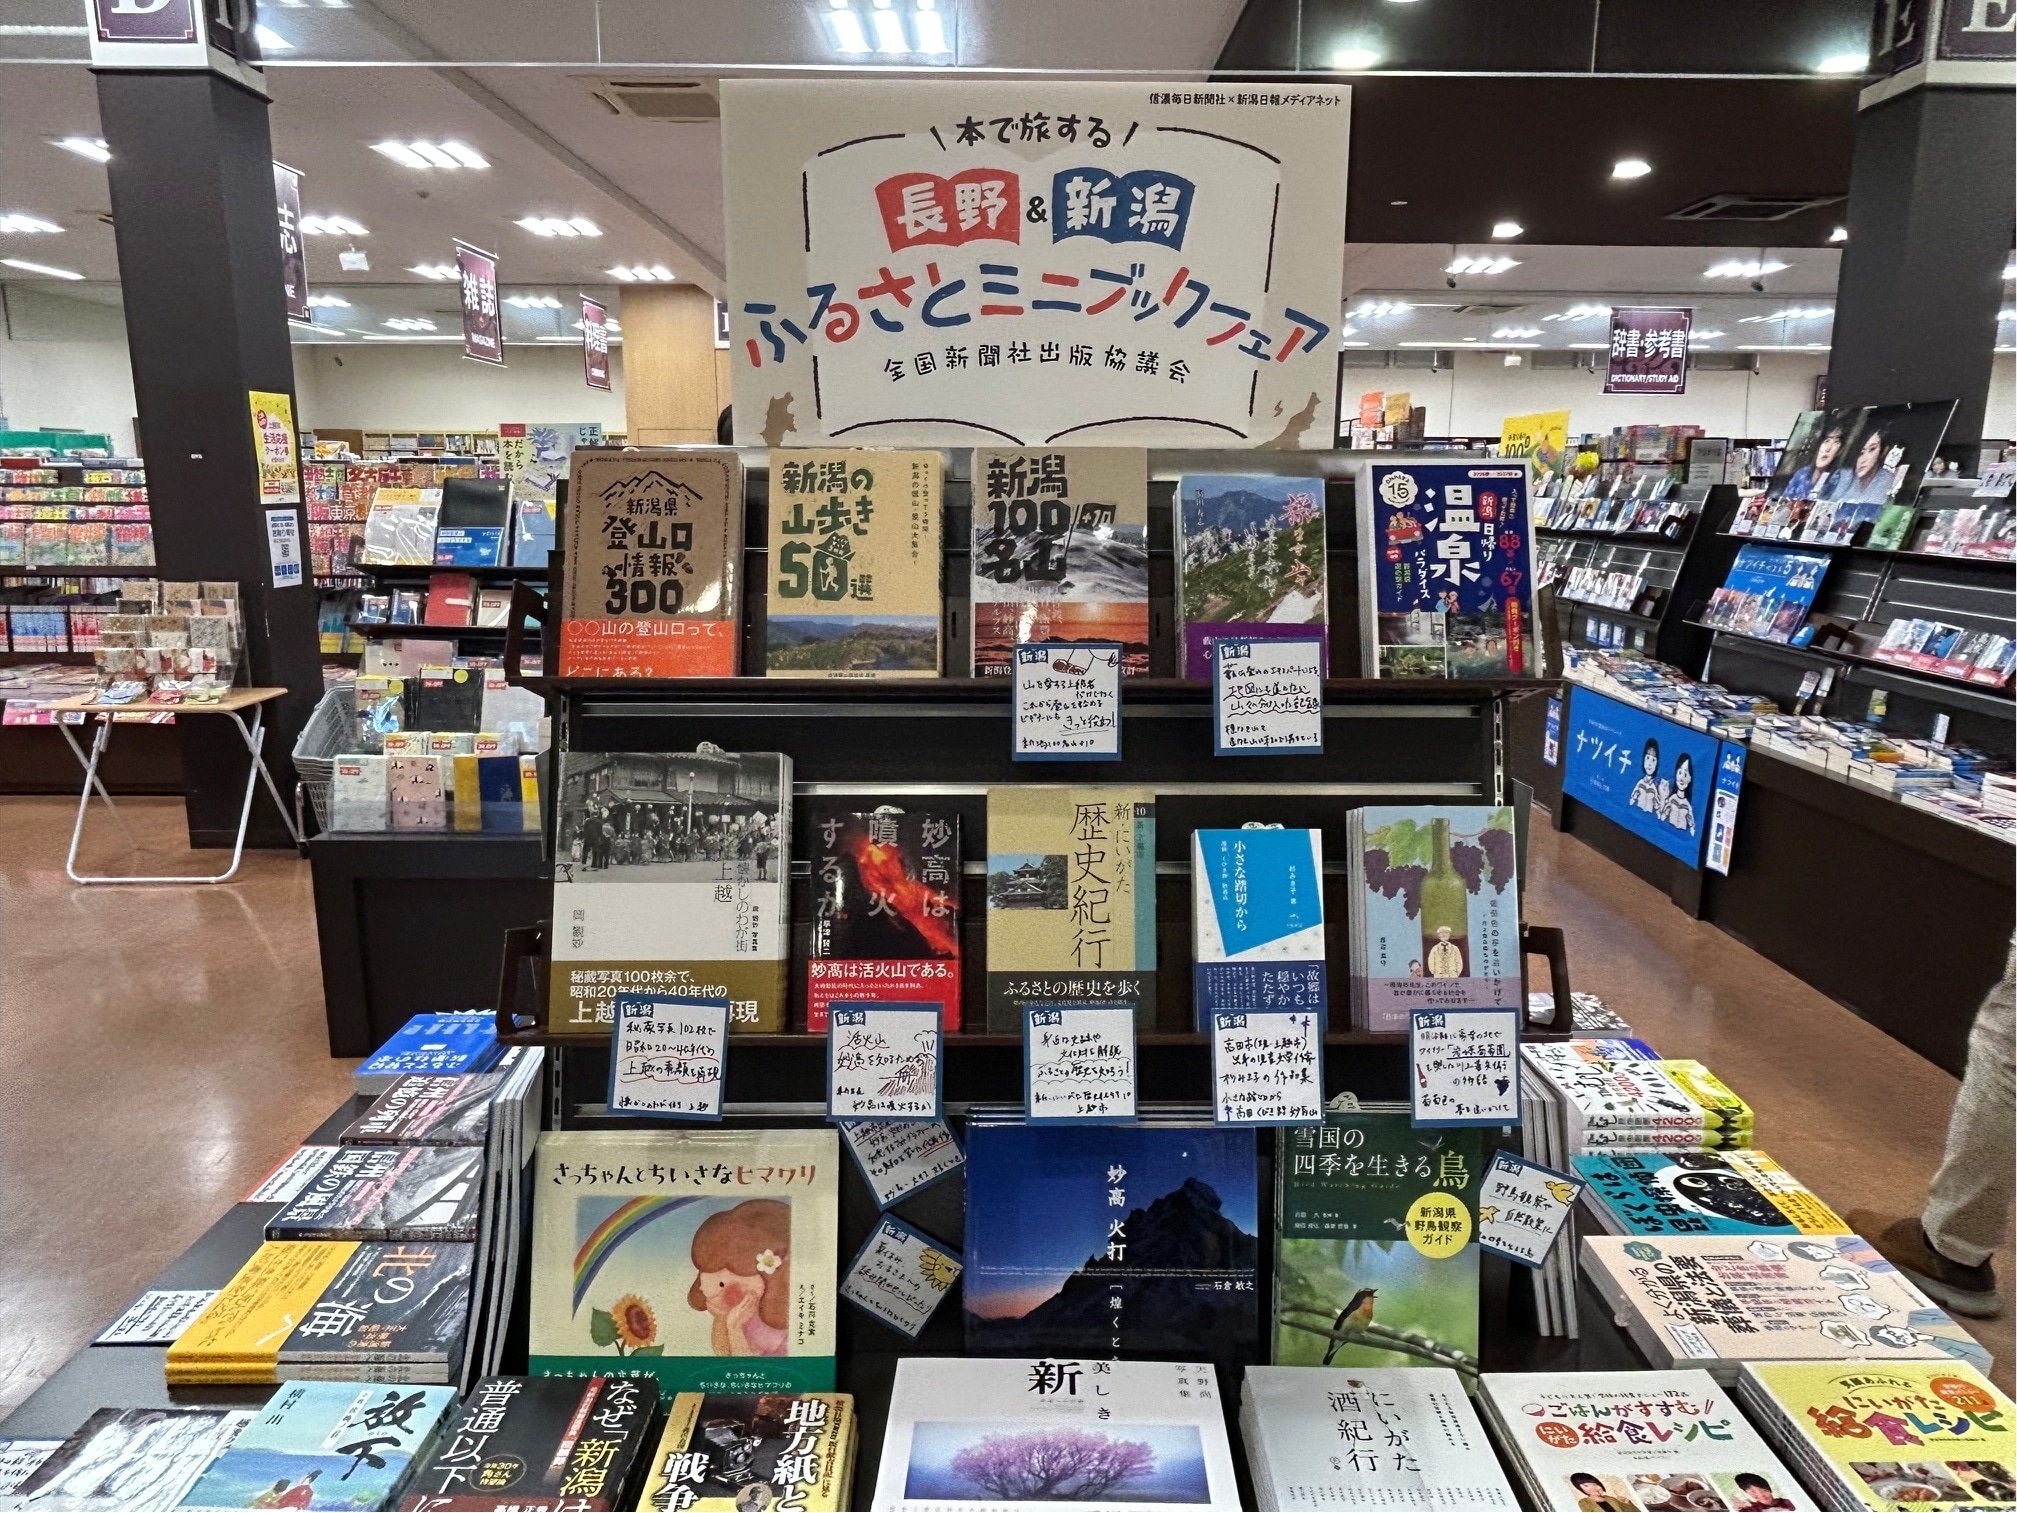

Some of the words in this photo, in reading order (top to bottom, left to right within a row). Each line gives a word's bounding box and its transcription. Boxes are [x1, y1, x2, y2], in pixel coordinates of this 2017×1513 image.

[956, 114, 1113, 148] 本で旅する
[895, 181, 1009, 238] 長野
[1026, 196, 1048, 222] &
[1064, 184, 1183, 238] 新潟
[463, 271, 495, 317] 雑誌
[745, 263, 1330, 368] ふるさとミニブックフェア
[1612, 329, 1686, 358] 辞書・参考書
[883, 343, 1192, 384] 全国新聞社出版協議会
[783, 460, 874, 493] 新潟の
[987, 455, 1068, 499] 新潟
[1388, 483, 1409, 498] 15
[626, 498, 677, 516] 新潟県
[781, 496, 874, 536] 山歩き
[987, 499, 1071, 535] 100
[1482, 496, 1494, 517] 新潟
[602, 516, 693, 550] 登山口
[1423, 485, 1481, 586] 温泉
[1480, 523, 1496, 562] 日帰り
[1499, 534, 1521, 549] 88
[622, 553, 677, 577] 情報
[982, 538, 1067, 583] 名山
[1414, 550, 1431, 599] パラダイス
[1500, 572, 1522, 586] 67
[605, 579, 684, 615] 300
[1019, 650, 1048, 664] 新潟
[1222, 646, 1250, 659] 新潟
[1577, 730, 1631, 774] ナツイチ
[713, 862, 733, 903] 上越
[816, 818, 846, 920] するか
[868, 818, 899, 918] 噴火
[922, 818, 953, 917] 妙高は
[1070, 803, 1112, 969] 歴史紀行
[1234, 840, 1248, 931] 小さな踏切から
[736, 863, 750, 952] 懐かしのわが街
[571, 970, 695, 983] 秘蔵写真100枚余で、
[811, 963, 954, 979] 妙高は活火山である。
[1004, 980, 1141, 997] ふるさとの歴史を歩く
[625, 1003, 653, 1017] 新潟
[729, 1001, 760, 1023] 現
[838, 1011, 866, 1025] 新潟
[1033, 1012, 1061, 1025] 新潟
[1218, 1015, 1246, 1029] 新潟
[1417, 1015, 1444, 1029] 新潟
[1294, 1126, 1364, 1149] 雪国の
[366, 1150, 400, 1179] 信州
[553, 1163, 817, 1186] さっちゃんとちいさなヒマワリ
[1294, 1150, 1470, 1190] 四季を生きる鳥
[283, 1150, 366, 1222] 国鉄の風景
[1107, 1165, 1127, 1207] 妙高
[1414, 1220, 1463, 1232] 野鳥観察
[1420, 1207, 1457, 1218] 新潟県
[1107, 1220, 1127, 1262] 火打
[1423, 1234, 1453, 1245] ガイド
[256, 1246, 438, 1347] 北の海へ
[1629, 1267, 1685, 1320] よく分かる
[1653, 1254, 1721, 1325] 新潟県の
[1668, 1254, 1759, 1335] 葬儀と法要
[1028, 1361, 1084, 1395] 新
[1092, 1361, 1111, 1420] 美しき
[1842, 1394, 1945, 1411] にいがた
[1327, 1390, 1379, 1473] 酒紀行
[1371, 1389, 1421, 1472] にいがた
[1577, 1419, 1734, 1445] 給食レシピ
[1807, 1404, 2009, 1447] 給食レシピ
[771, 1399, 829, 1512] 地方紙と
[652, 1453, 709, 1512] 戦争
